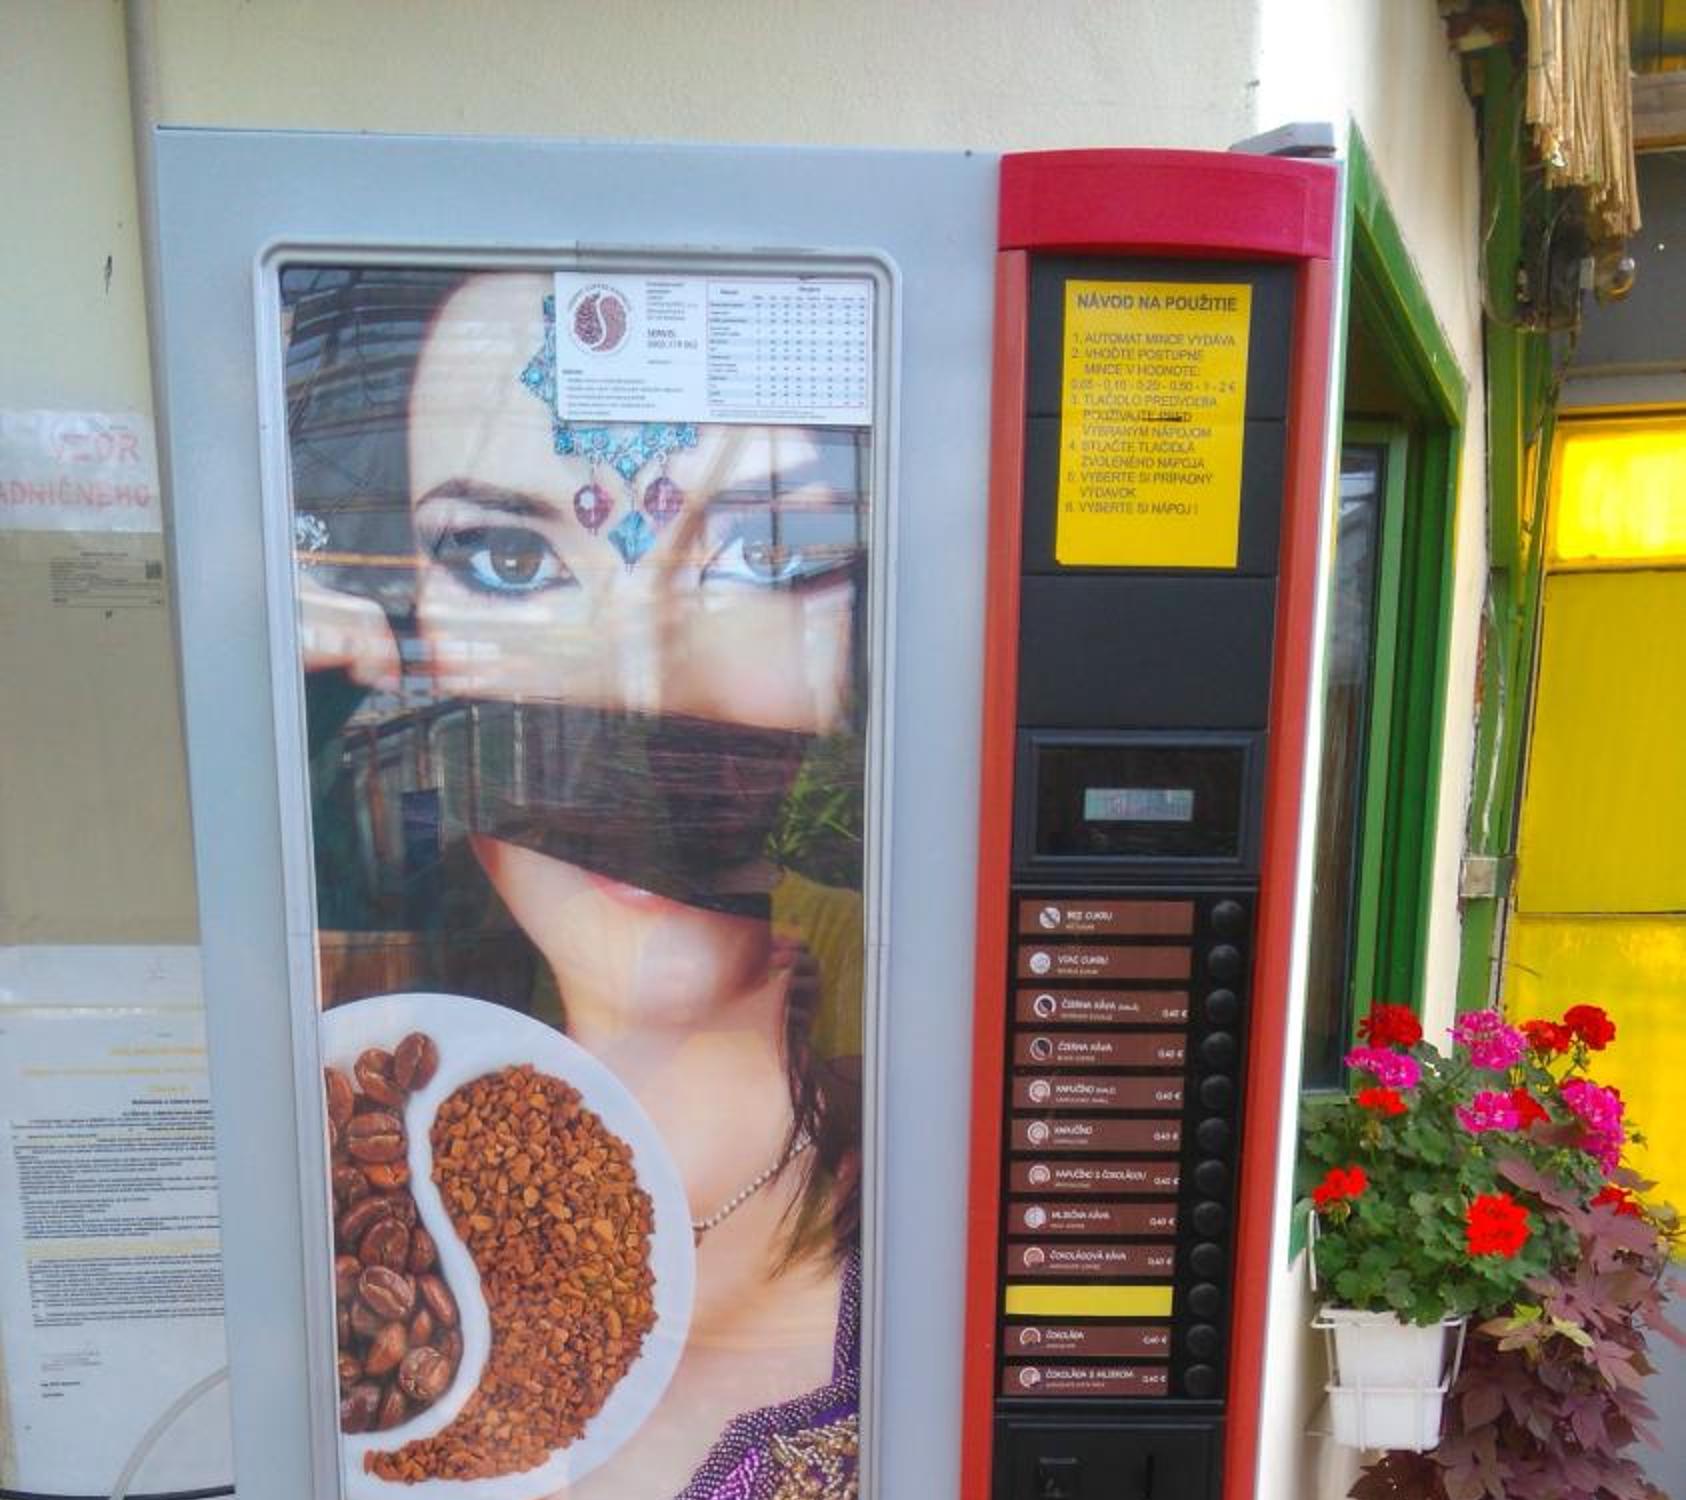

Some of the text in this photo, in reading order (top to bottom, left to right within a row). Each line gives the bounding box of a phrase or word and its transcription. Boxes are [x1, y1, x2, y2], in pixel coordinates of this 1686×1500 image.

[1076, 292, 1238, 313] NÁVOD NA POUŽITIE
